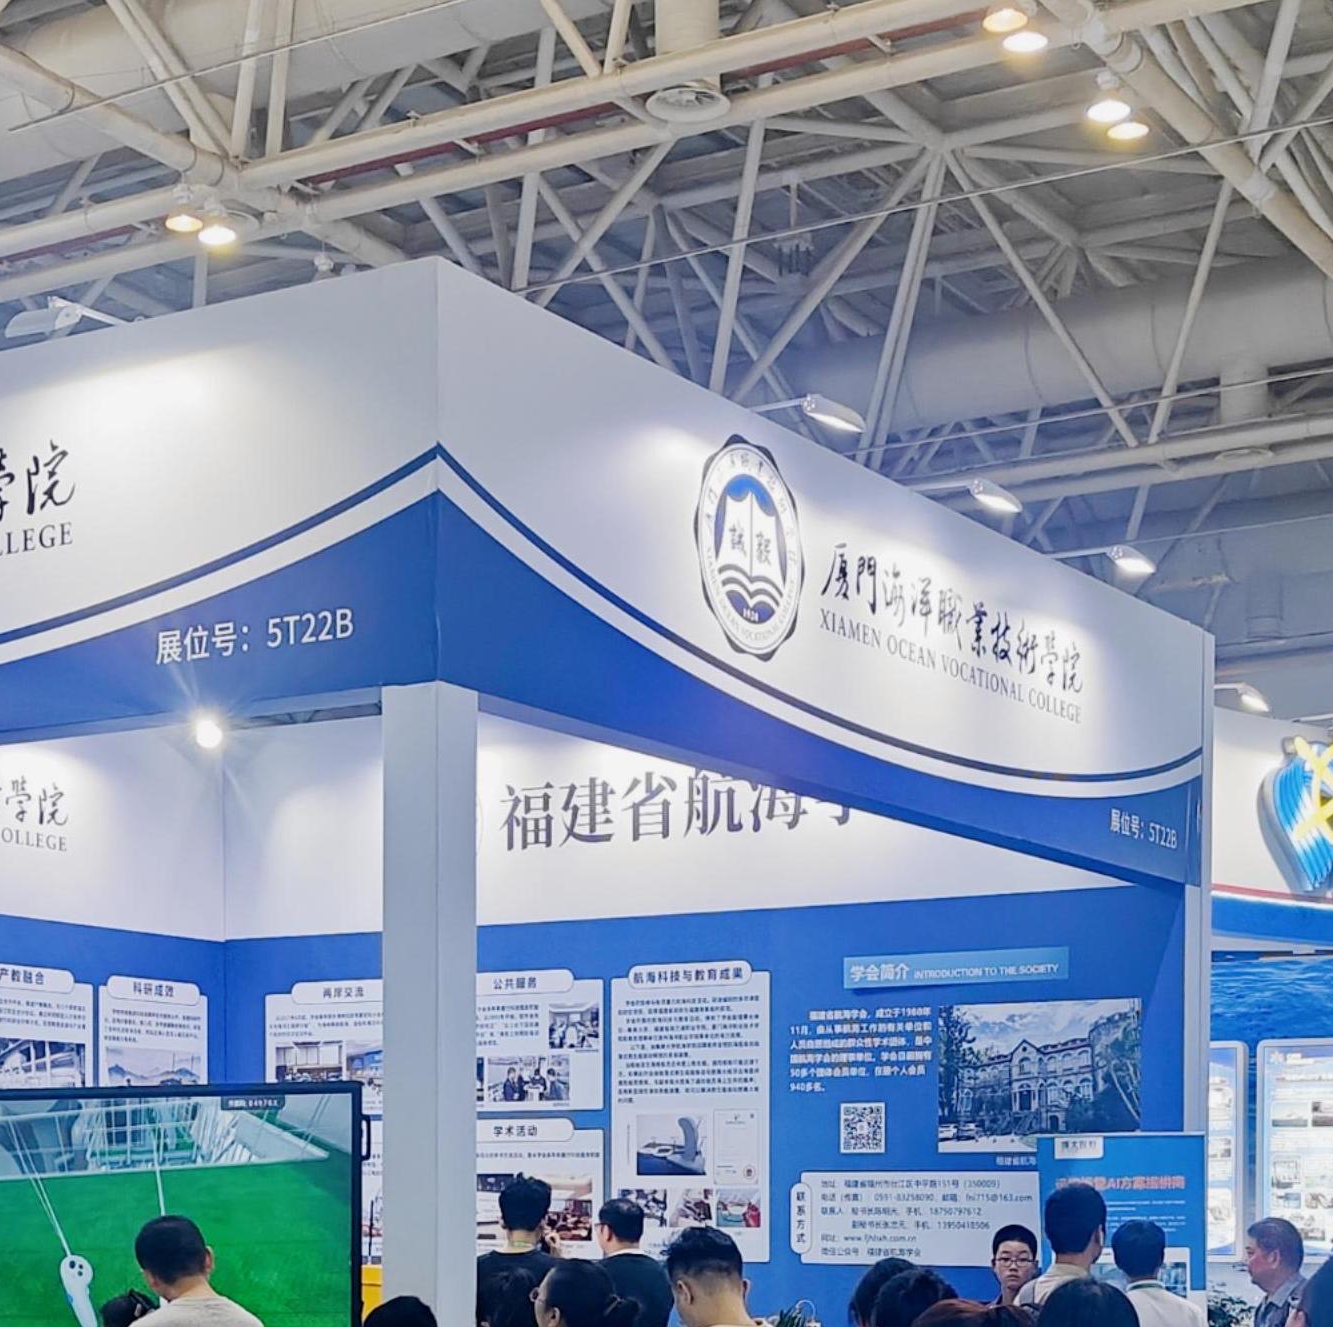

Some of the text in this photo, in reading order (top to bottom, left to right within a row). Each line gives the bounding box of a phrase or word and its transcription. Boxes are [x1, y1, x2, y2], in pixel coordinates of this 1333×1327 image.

[819, 608, 1082, 724] XIAMEN OCEAN VOCATIONAL COLLEGE
[0, 967, 45, 986] 产教融合
[633, 967, 743, 984] 航海科技与教育成果
[850, 963, 909, 981] 学会简介
[914, 963, 1059, 979] INTRODUCTION TO THE SOCIETY
[493, 977, 537, 990] 公共服务
[322, 986, 365, 999] 两岸交流
[493, 1125, 538, 1138] 学术活动
